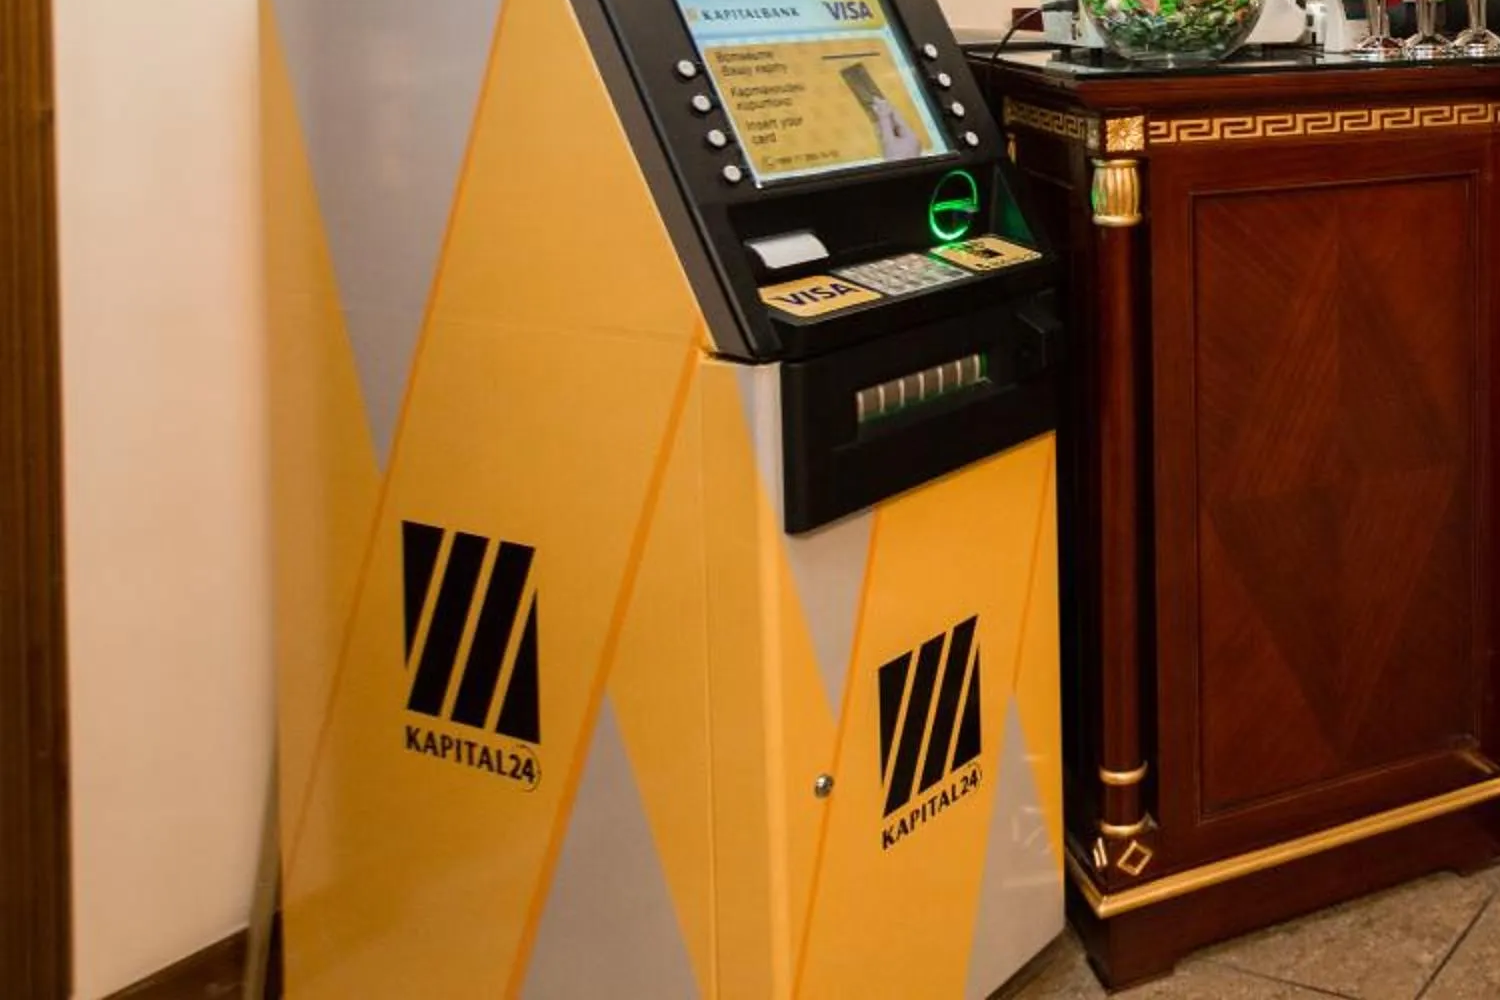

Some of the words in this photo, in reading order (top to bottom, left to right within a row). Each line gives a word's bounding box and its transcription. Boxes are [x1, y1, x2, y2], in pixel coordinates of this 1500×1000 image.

[701, 7, 799, 21] KAPITALBANK
[821, 1, 873, 20] VISA
[751, 132, 777, 144] card
[777, 283, 860, 307] VISA
[405, 725, 536, 784] KAPITAL24
[881, 774, 979, 850] KAPITAL24
